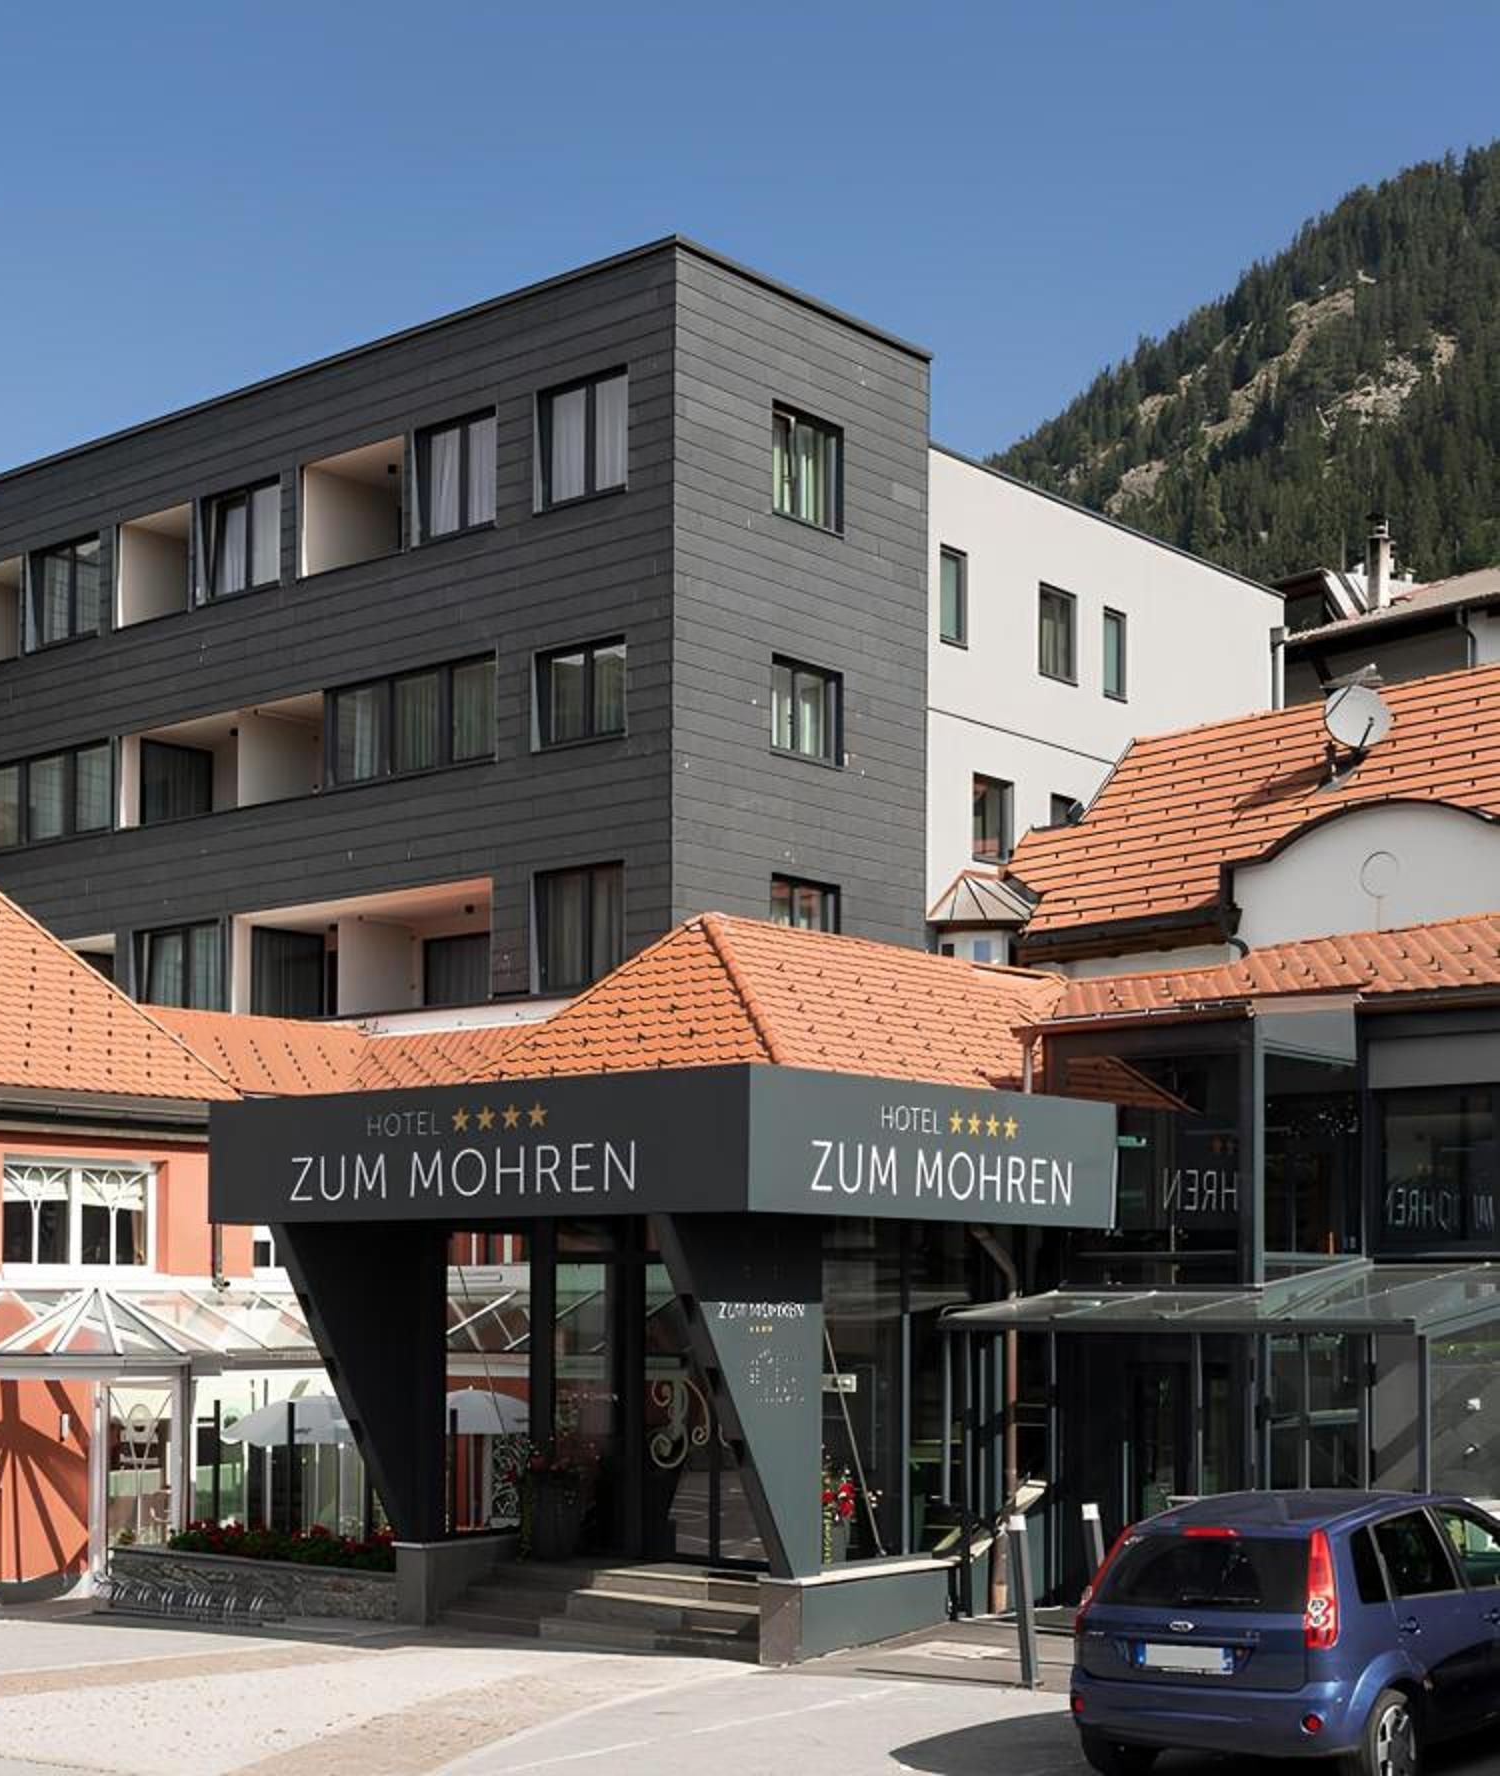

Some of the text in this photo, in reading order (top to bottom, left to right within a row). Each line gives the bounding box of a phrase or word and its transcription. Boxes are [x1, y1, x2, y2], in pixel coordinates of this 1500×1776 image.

[366, 1110, 441, 1137] HOTEL
[881, 1105, 942, 1135] HOTEL
[290, 1140, 637, 1201] ZUM MOHREN
[810, 1140, 1073, 1207] ZUM MOHREN
